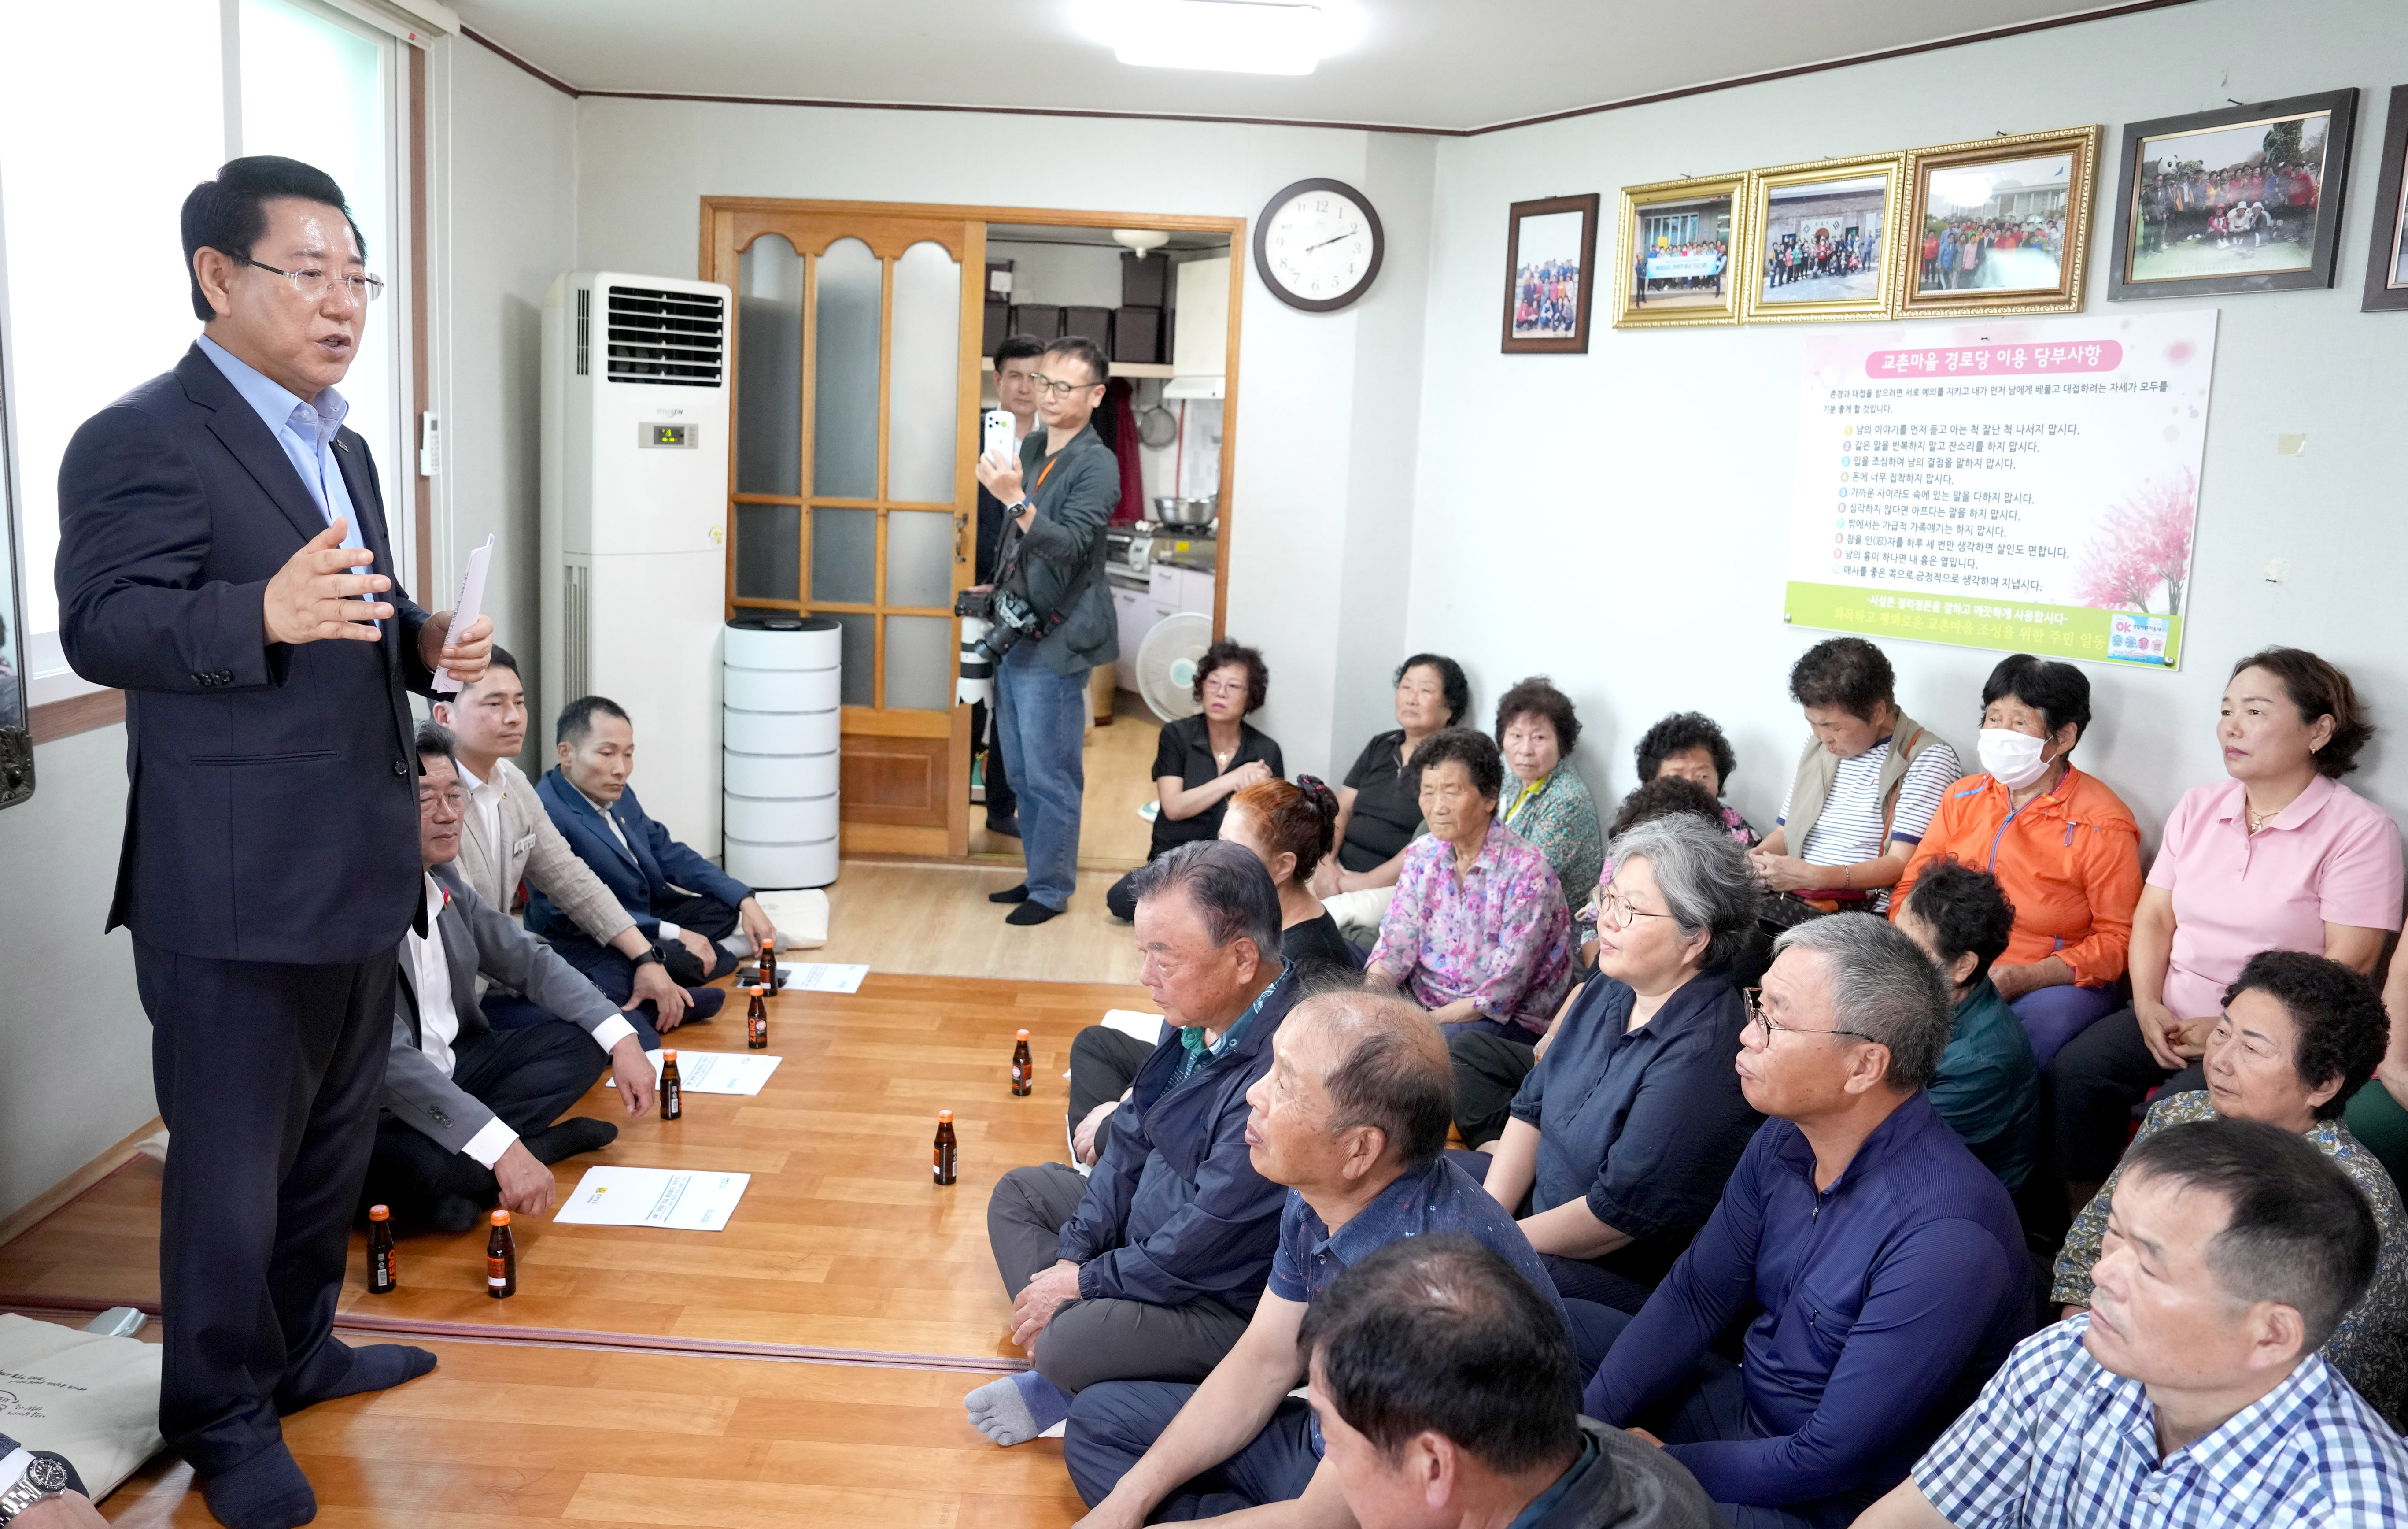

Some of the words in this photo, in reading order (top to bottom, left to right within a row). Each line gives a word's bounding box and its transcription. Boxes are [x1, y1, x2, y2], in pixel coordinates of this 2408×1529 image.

[1316, 200, 1329, 212] 12
[1881, 352, 1939, 373] 교촌마을
[1945, 350, 1991, 371] 경로당
[1996, 348, 2028, 369] 이용
[2035, 344, 2102, 368] 당부사항
[1852, 389, 1872, 398] 대접을
[1875, 388, 1903, 398] 받으려면
[1905, 388, 1920, 397] 서로
[1922, 387, 1944, 397] 예의를
[1946, 387, 1969, 396] 지키고
[1972, 386, 1987, 396] 내가
[1990, 385, 2005, 396] 먼저
[2009, 385, 2033, 395] 남에게
[2035, 384, 2060, 395] 베풀고
[2063, 383, 2107, 394] 대접하려는
[2109, 382, 2137, 393] 자세가
[2139, 381, 2168, 392] 모두를
[1823, 405, 1836, 414] 기분
[1863, 404, 1892, 414] 것입니다.
[1857, 425, 1872, 435] 남의
[1875, 424, 1907, 435] 이야기를
[1910, 424, 1927, 435] 먼저
[1929, 424, 1947, 435] 듣고
[1950, 424, 1968, 435] 아는
[1970, 424, 1979, 435] 척
[1982, 424, 2001, 436] 잘난
[2004, 424, 2012, 435] 척
[2016, 424, 2044, 436] 나서지
[2048, 423, 2080, 436] 맙시다.
[1855, 441, 1870, 451] 같은
[1874, 440, 1889, 451] 말을
[1892, 441, 1925, 452] 반복하지
[1929, 441, 1945, 452] 말고
[1948, 441, 1984, 452] 잔소리를
[1987, 441, 2005, 452] 하지
[2009, 441, 2039, 453] 맙시다.
[1854, 456, 1869, 467] 입을
[1872, 456, 1905, 467] 조심하여
[1908, 457, 1924, 468] 남의
[1927, 457, 1953, 469] 결점을
[1956, 458, 1982, 469] 말하지
[1986, 458, 2016, 470] 맙시다.
[1852, 472, 1868, 482] 돈에
[1871, 472, 1887, 483] 너무
[1890, 473, 1922, 484] 집착하지
[1926, 474, 1954, 485] 맙시다.
[1850, 488, 1875, 499] 가까운
[1877, 488, 1910, 500] 사이라도
[1913, 489, 1930, 501] 속에
[1933, 490, 1950, 501] 있는
[1953, 491, 1970, 502] 말을
[1973, 491, 2000, 503] 다하지
[2004, 492, 2035, 504] 맙시다.
[1850, 503, 1881, 515] 심각하지
[1884, 504, 1908, 516] 않다면
[1912, 506, 1946, 518] 아프다는
[1949, 507, 1966, 519] 말을
[1969, 508, 1987, 520] 하지
[1991, 509, 2020, 521] 맙시다.
[1848, 518, 1880, 530] 밖에서는
[1882, 520, 1907, 532] 가급적
[1910, 522, 1953, 534] 가족얘기는
[1956, 524, 1973, 536] 하지
[1977, 525, 2006, 537] 맙시다.
[1847, 534, 1862, 545] 참을
[1907, 538, 1923, 549] 하루
[1926, 539, 1935, 550] 세
[1938, 540, 1955, 551] 번만
[1957, 541, 1993, 554] 생각하면
[1997, 543, 2024, 555] 살인도
[2028, 545, 2069, 559] 면합니다.
[1846, 550, 1861, 561] 남의
[1882, 552, 1906, 564] 하나면
[1909, 554, 1918, 565] 내
[1941, 556, 1978, 569] 열입니다.
[1844, 565, 1867, 577] 매사를
[1870, 567, 1886, 578] 좋은
[1889, 569, 1913, 580] 쪽으로
[1916, 571, 1959, 583] 긍정적으로
[1962, 575, 1998, 588] 생각하며
[2002, 578, 2042, 592] 지냅시다.
[1898, 597, 1941, 613] 정리정돈을
[1944, 602, 1971, 615] 잘하고
[1973, 605, 2012, 620] 깨끗하게
[1978, 623, 2014, 640] 조성을
[2020, 627, 2045, 643] 위한
[2049, 630, 2074, 646] 주민
[2081, 633, 2106, 650] 일동
